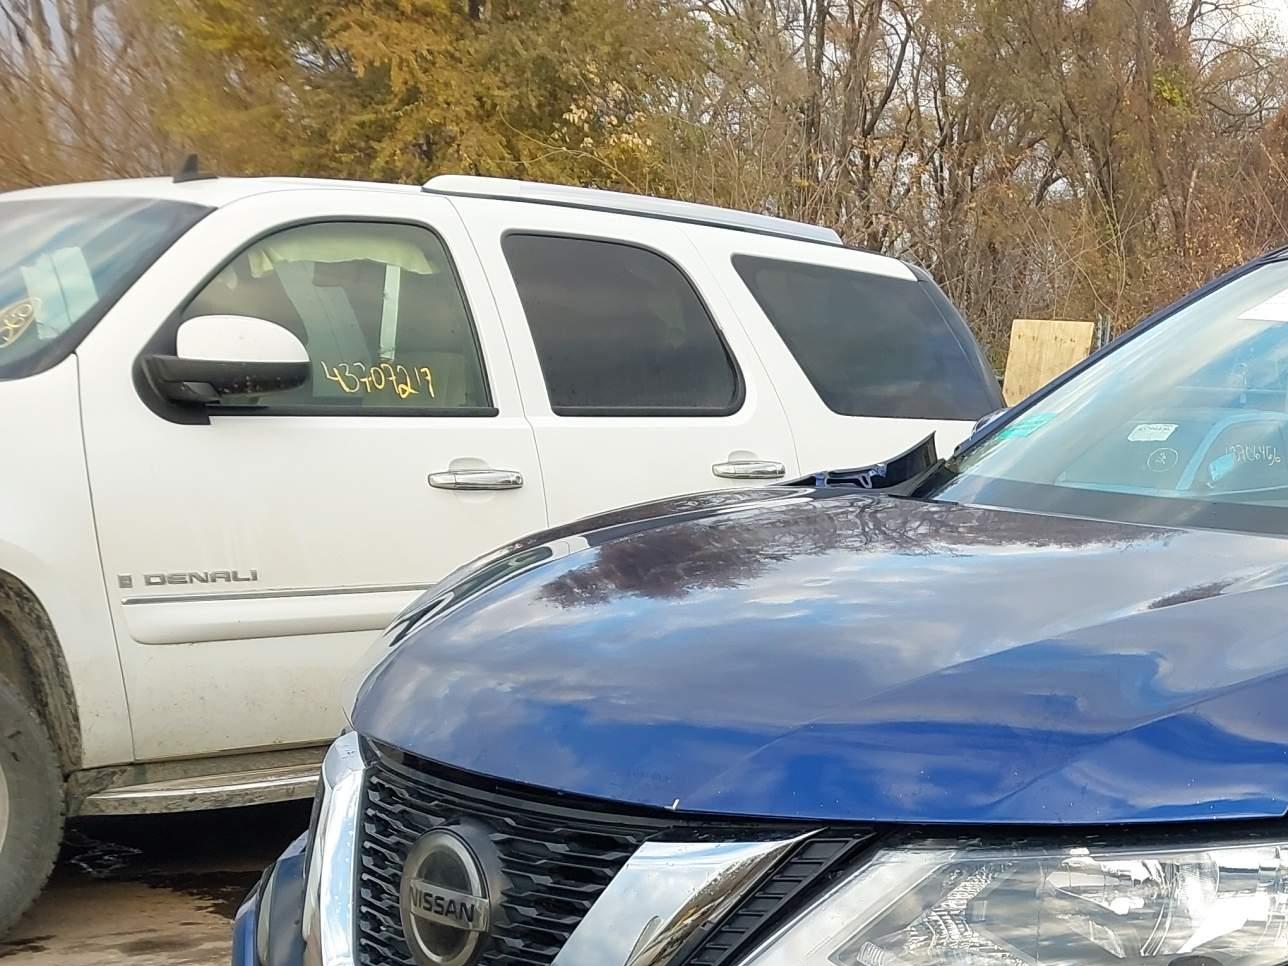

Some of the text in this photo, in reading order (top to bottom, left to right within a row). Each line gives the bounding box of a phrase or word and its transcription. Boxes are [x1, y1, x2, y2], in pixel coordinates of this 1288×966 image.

[320, 360, 435, 399] 43707217
[143, 569, 258, 587] DENALI
[409, 884, 475, 923] NISSAN
